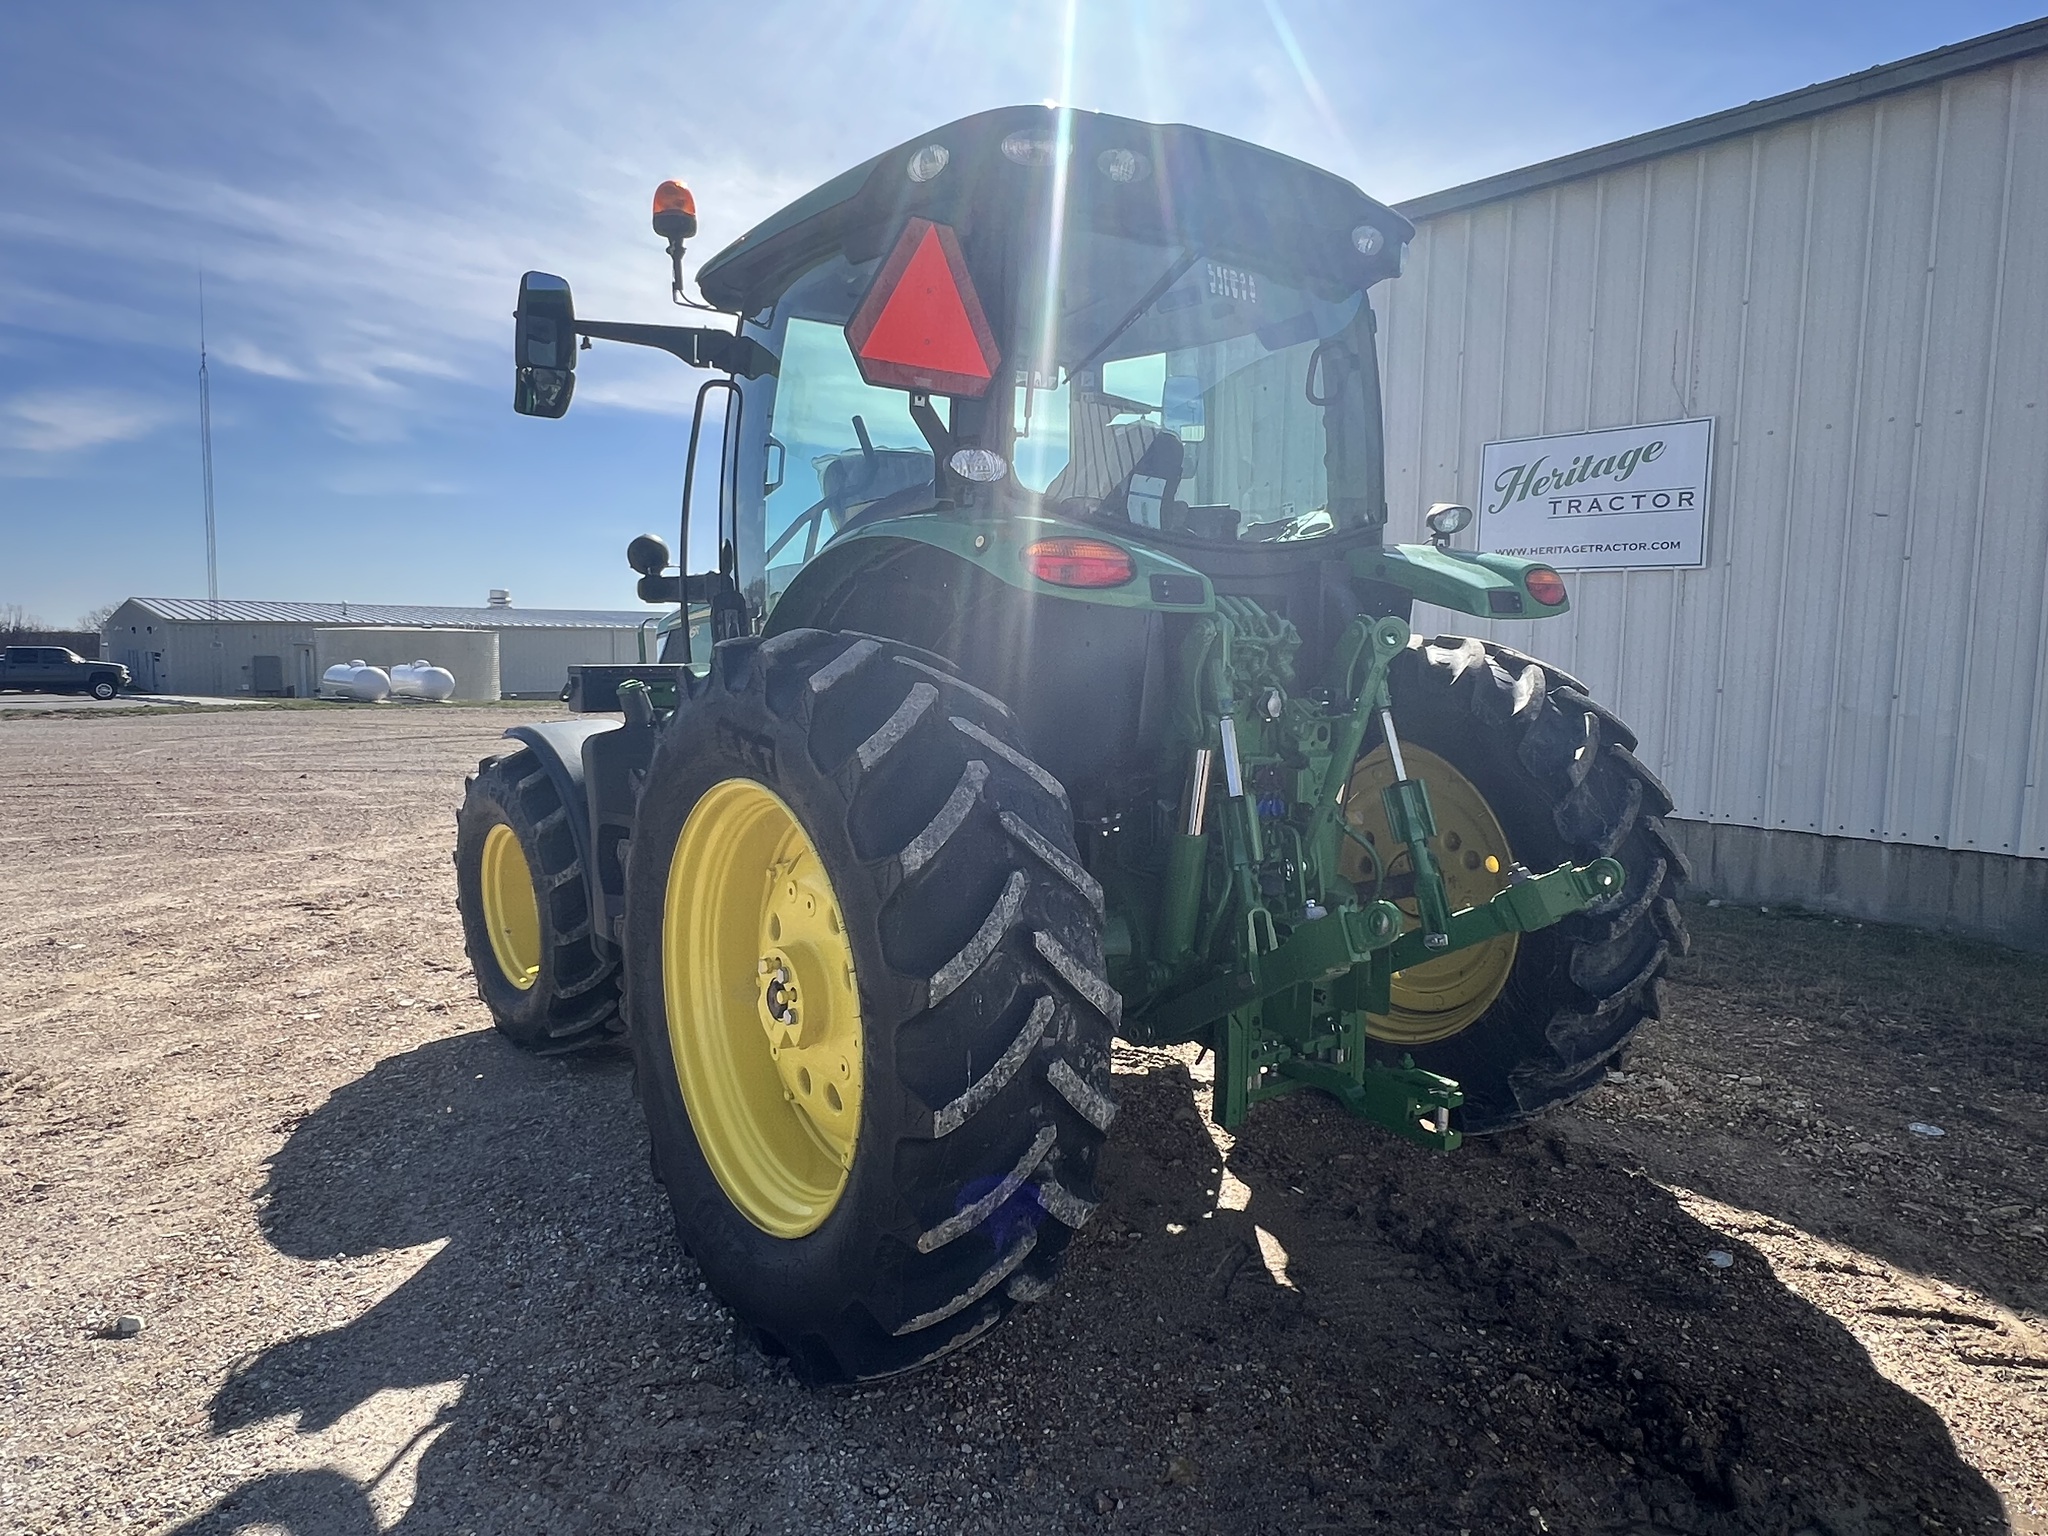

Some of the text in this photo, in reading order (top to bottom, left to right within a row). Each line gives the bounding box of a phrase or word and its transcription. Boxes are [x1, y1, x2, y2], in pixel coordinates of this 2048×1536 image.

[1488, 440, 1667, 515] Heritage
[1548, 491, 1695, 515] TRACTOR
[1495, 541, 1681, 556] WWW.HERITAGETRACTOR.COM
